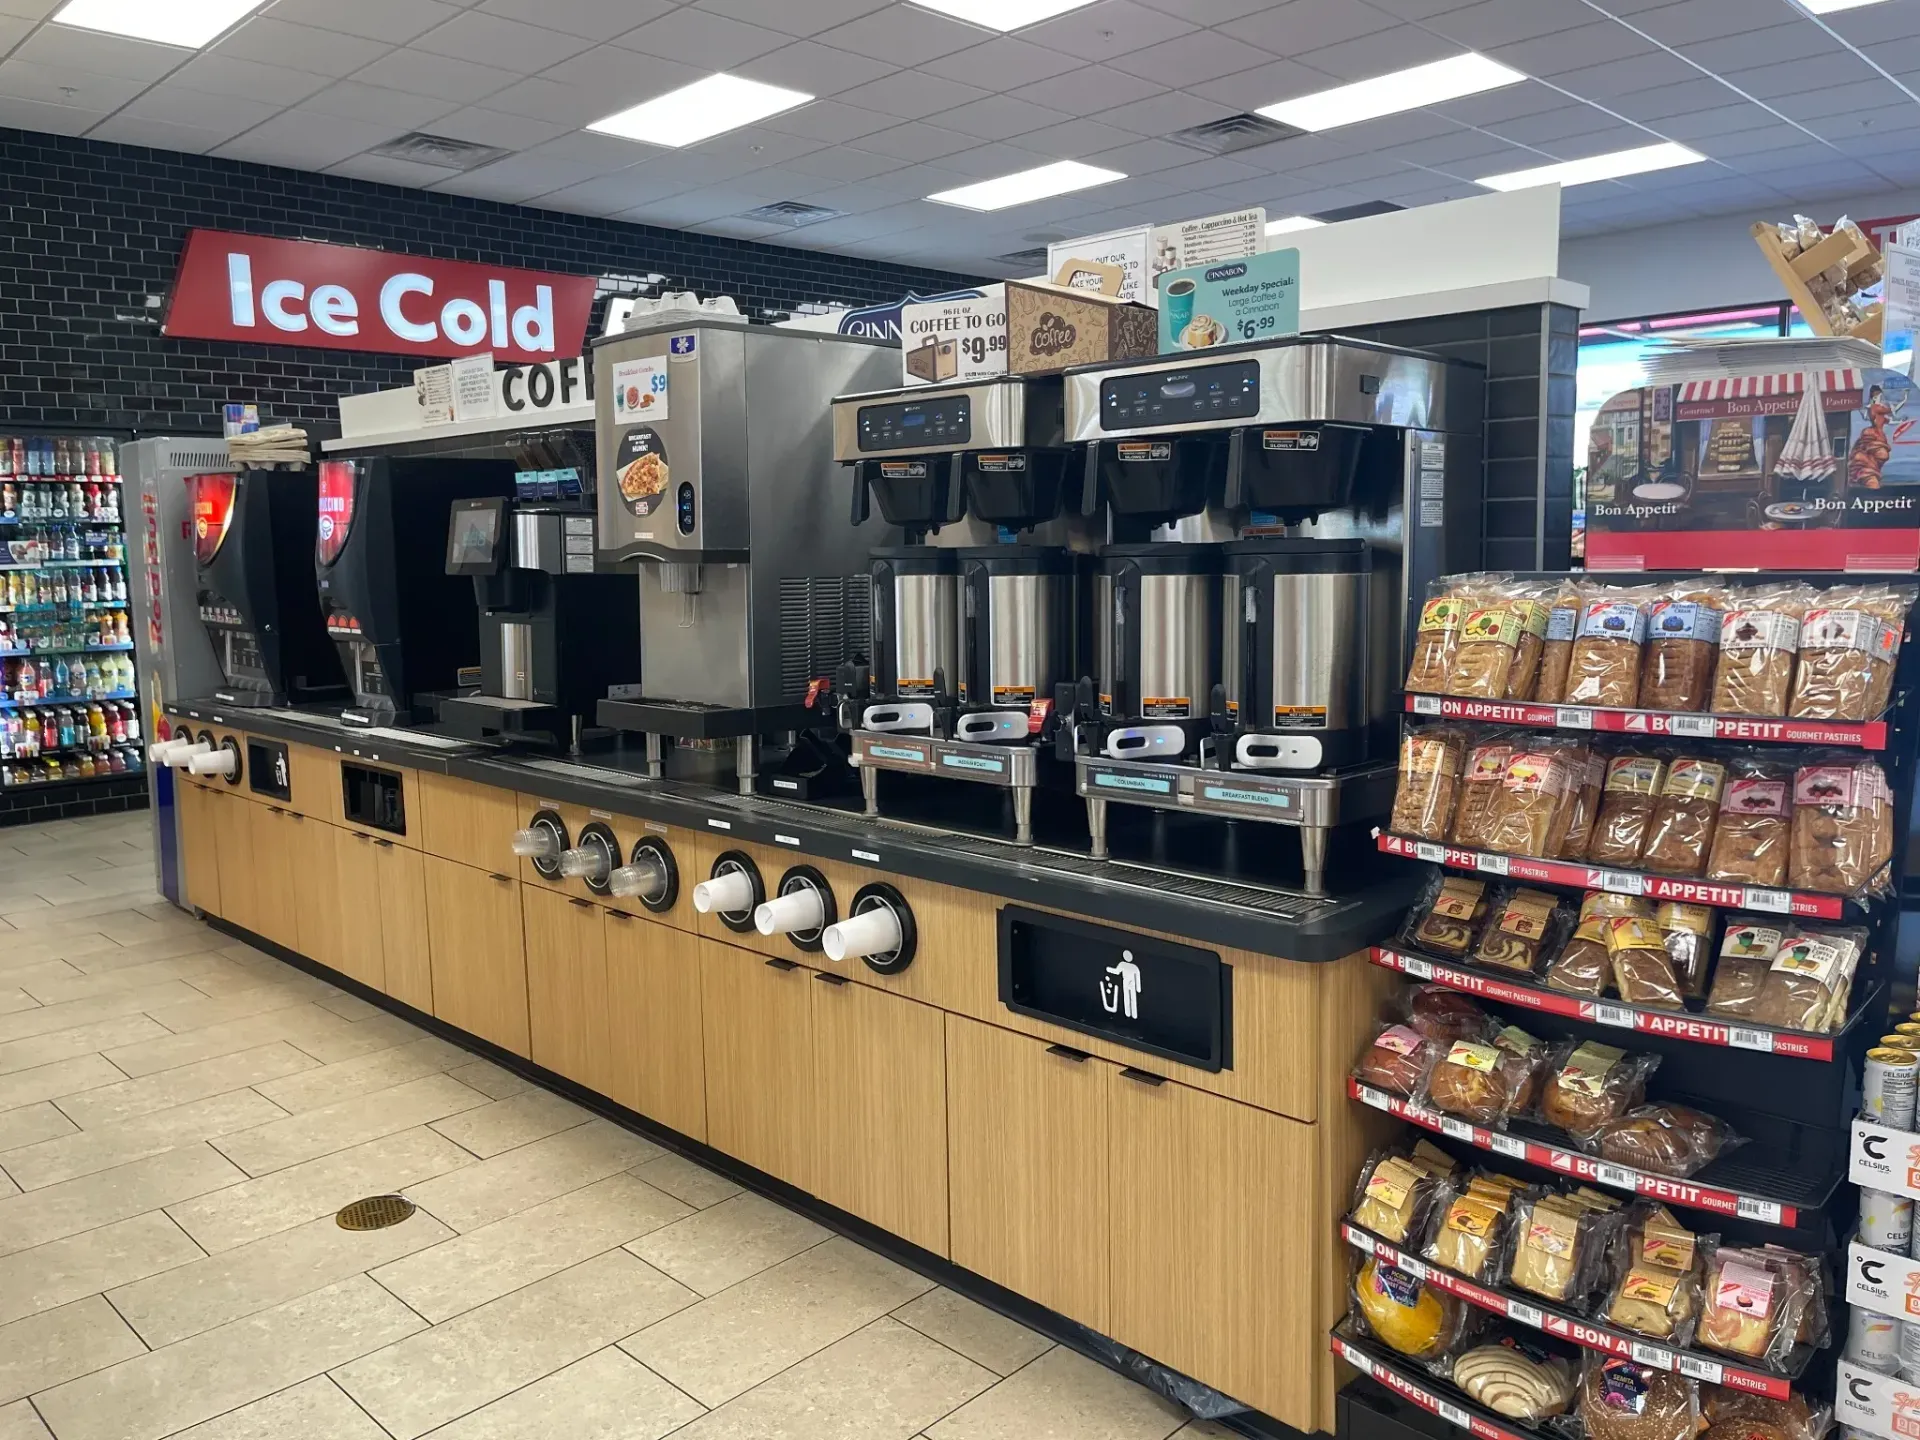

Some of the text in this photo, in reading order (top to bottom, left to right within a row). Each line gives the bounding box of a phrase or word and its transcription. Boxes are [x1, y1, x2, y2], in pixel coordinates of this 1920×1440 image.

[1237, 214, 1247, 222] Hot
[1110, 253, 1126, 263] OUR
[1129, 261, 1138, 269] TO
[1206, 266, 1244, 280] CINNABON
[1122, 281, 1138, 290] LIKE
[1221, 277, 1294, 297] Weekday Special:
[227, 252, 556, 352] Ice Cold
[1228, 297, 1250, 308] Large
[1251, 292, 1277, 304] Coffee
[943, 308, 953, 316] 96
[1242, 302, 1280, 315] Cinnabon
[910, 312, 1006, 334] COFFEE TO GO
[1236, 315, 1275, 340] $6.99
[961, 335, 1007, 364] $9.99
[1679, 398, 1800, 417] Gourmet Bon Appetit
[628, 433, 652, 442] BREAKFAST
[1594, 503, 1677, 519] Bon Appetit
[1814, 496, 1913, 513] Bon Appetit
[1440, 700, 1555, 723] ON APPETIT GOURMET
[1786, 730, 1823, 741] GOURMET
[1824, 732, 1862, 743] PASTRIES
[1221, 791, 1269, 803] BREAKFAST BLEND
[1521, 866, 1549, 878] PASTRIES
[1657, 880, 1739, 904] APPETIT
[1812, 949, 1833, 959] COFFEE
[1813, 944, 1835, 954] CHEESE
[1812, 954, 1828, 962] CAKE
[1486, 985, 1512, 999] GOURMET
[1513, 991, 1541, 1006] PASTRIES
[1650, 1016, 1809, 1054] APPETIT PASTRIES
[1858, 1159, 1890, 1172] CELSIUS
[1702, 1196, 1737, 1211] GOURMET
[1856, 1282, 1888, 1297] CELSIUS
[1456, 1284, 1481, 1304] GOURMET
[1482, 1296, 1507, 1311] PASTRIE
[1573, 1326, 1611, 1348] BON
[1732, 1376, 1767, 1391] PASTRIES
[1613, 1373, 1634, 1385] SEMITA
[1844, 1399, 1875, 1415] CELSIUS
[1471, 1421, 1498, 1440] PASTRIES
